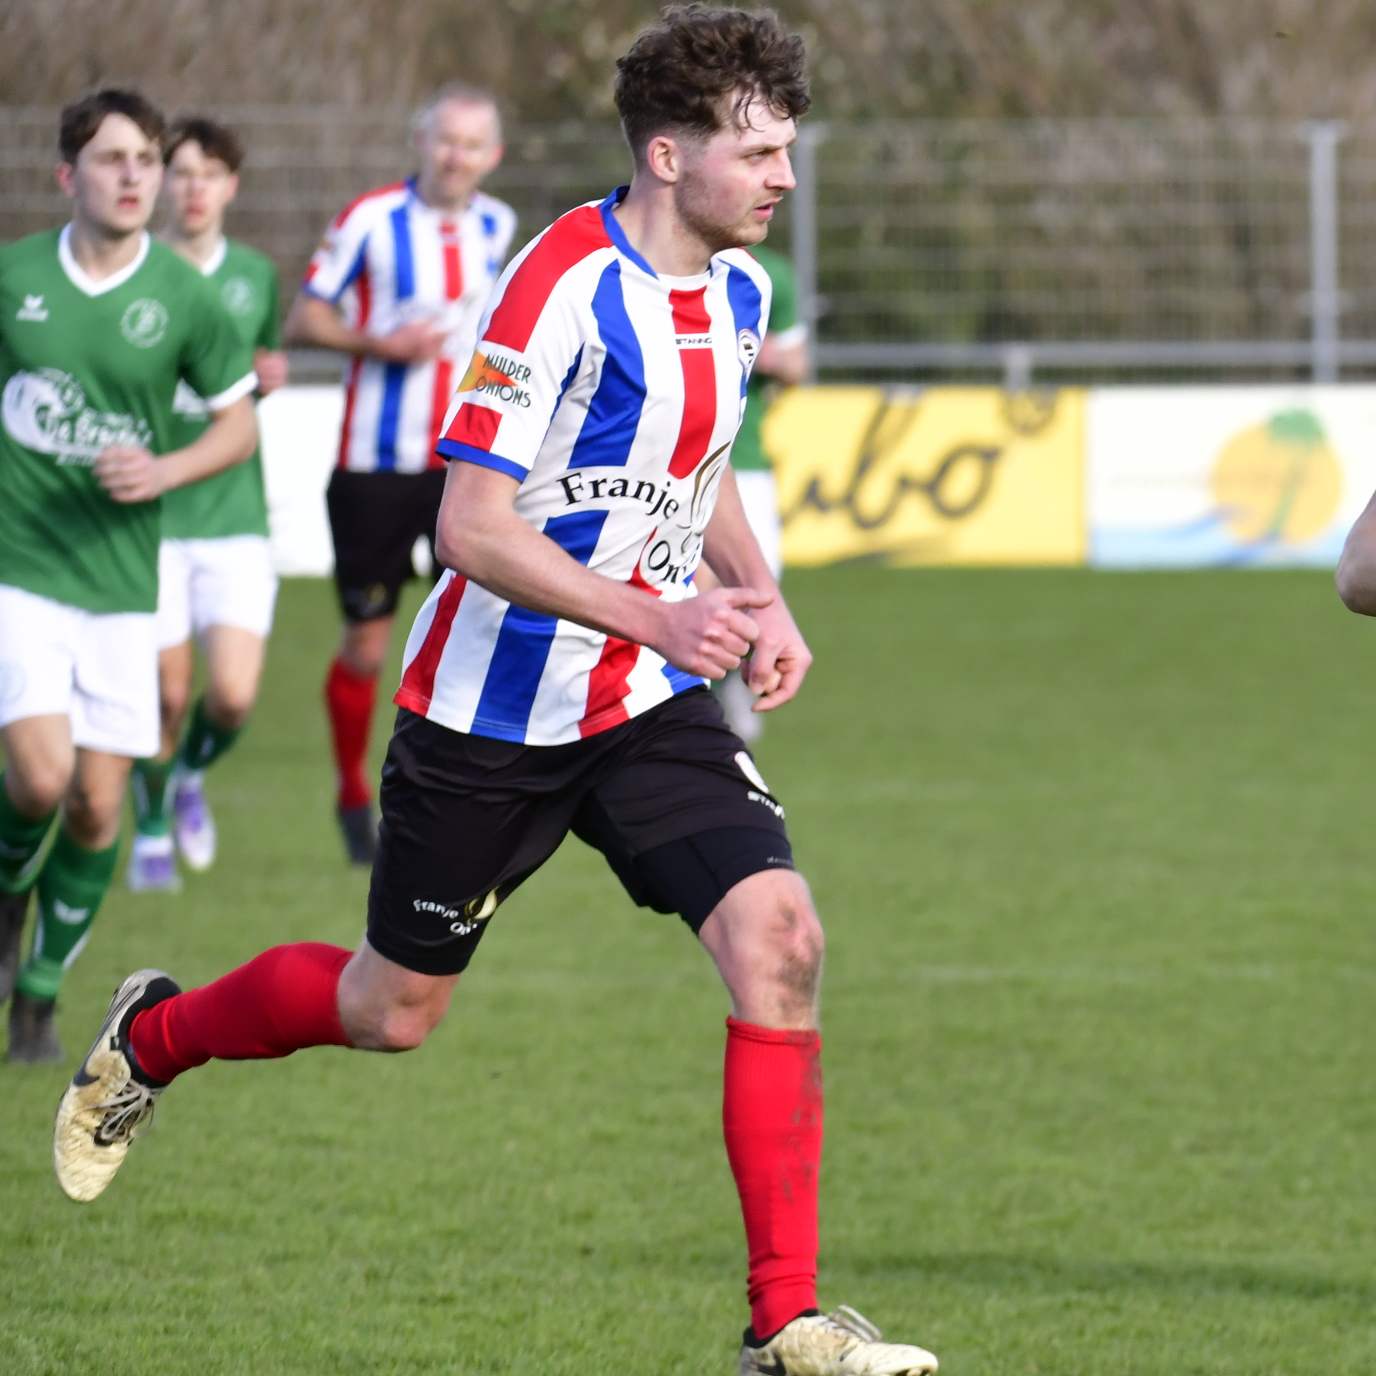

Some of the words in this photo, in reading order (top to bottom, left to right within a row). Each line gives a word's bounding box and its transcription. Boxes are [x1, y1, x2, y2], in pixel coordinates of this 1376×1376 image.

[483, 353, 532, 383] MULDER
[476, 376, 532, 408] ONIONS
[556, 471, 679, 520] Franje
[413, 899, 459, 918] Franje
